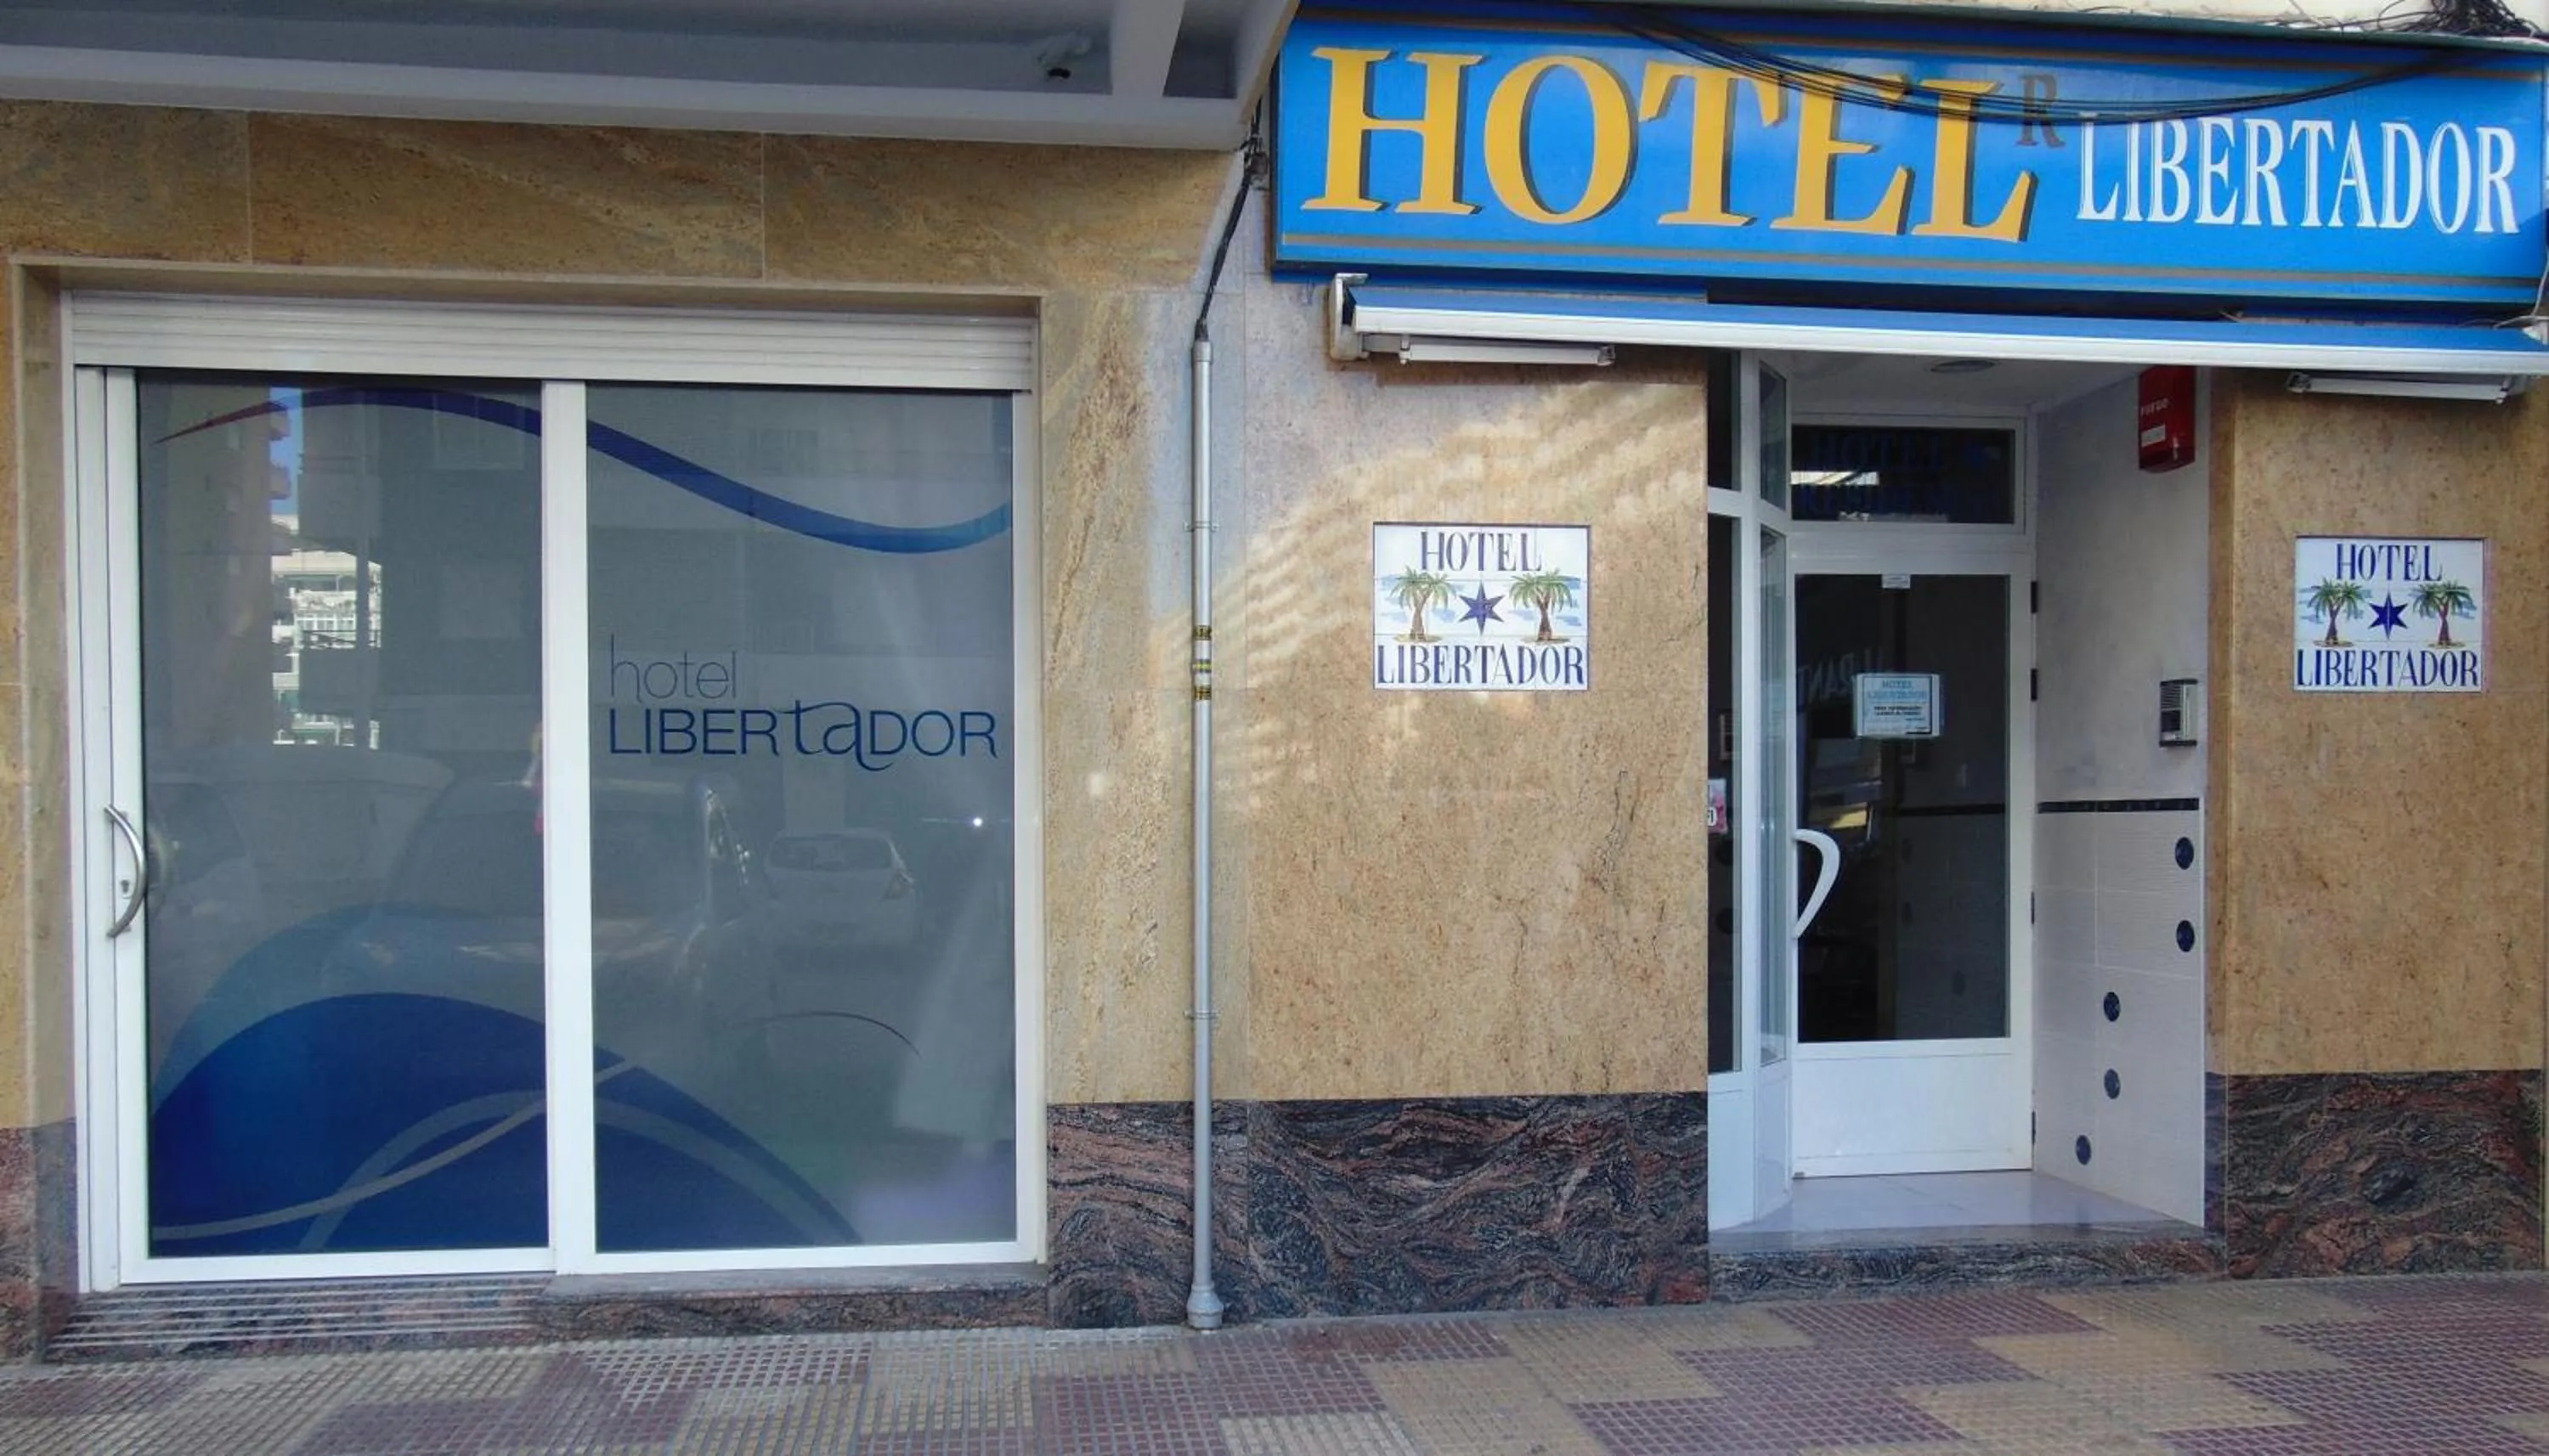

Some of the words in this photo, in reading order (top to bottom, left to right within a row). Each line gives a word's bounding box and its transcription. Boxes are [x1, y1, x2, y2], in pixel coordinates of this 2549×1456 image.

[1300, 47, 2036, 243] HOTEL
[2015, 73, 2066, 148] R
[2077, 111, 2519, 234] LIBERTADOR
[1420, 531, 1542, 572] HOTEL
[2337, 544, 2443, 582] HOTEL
[609, 633, 738, 703] hotel
[1377, 643, 1585, 686] LIBERTADOR
[2297, 649, 2478, 687] LIBERTADOR
